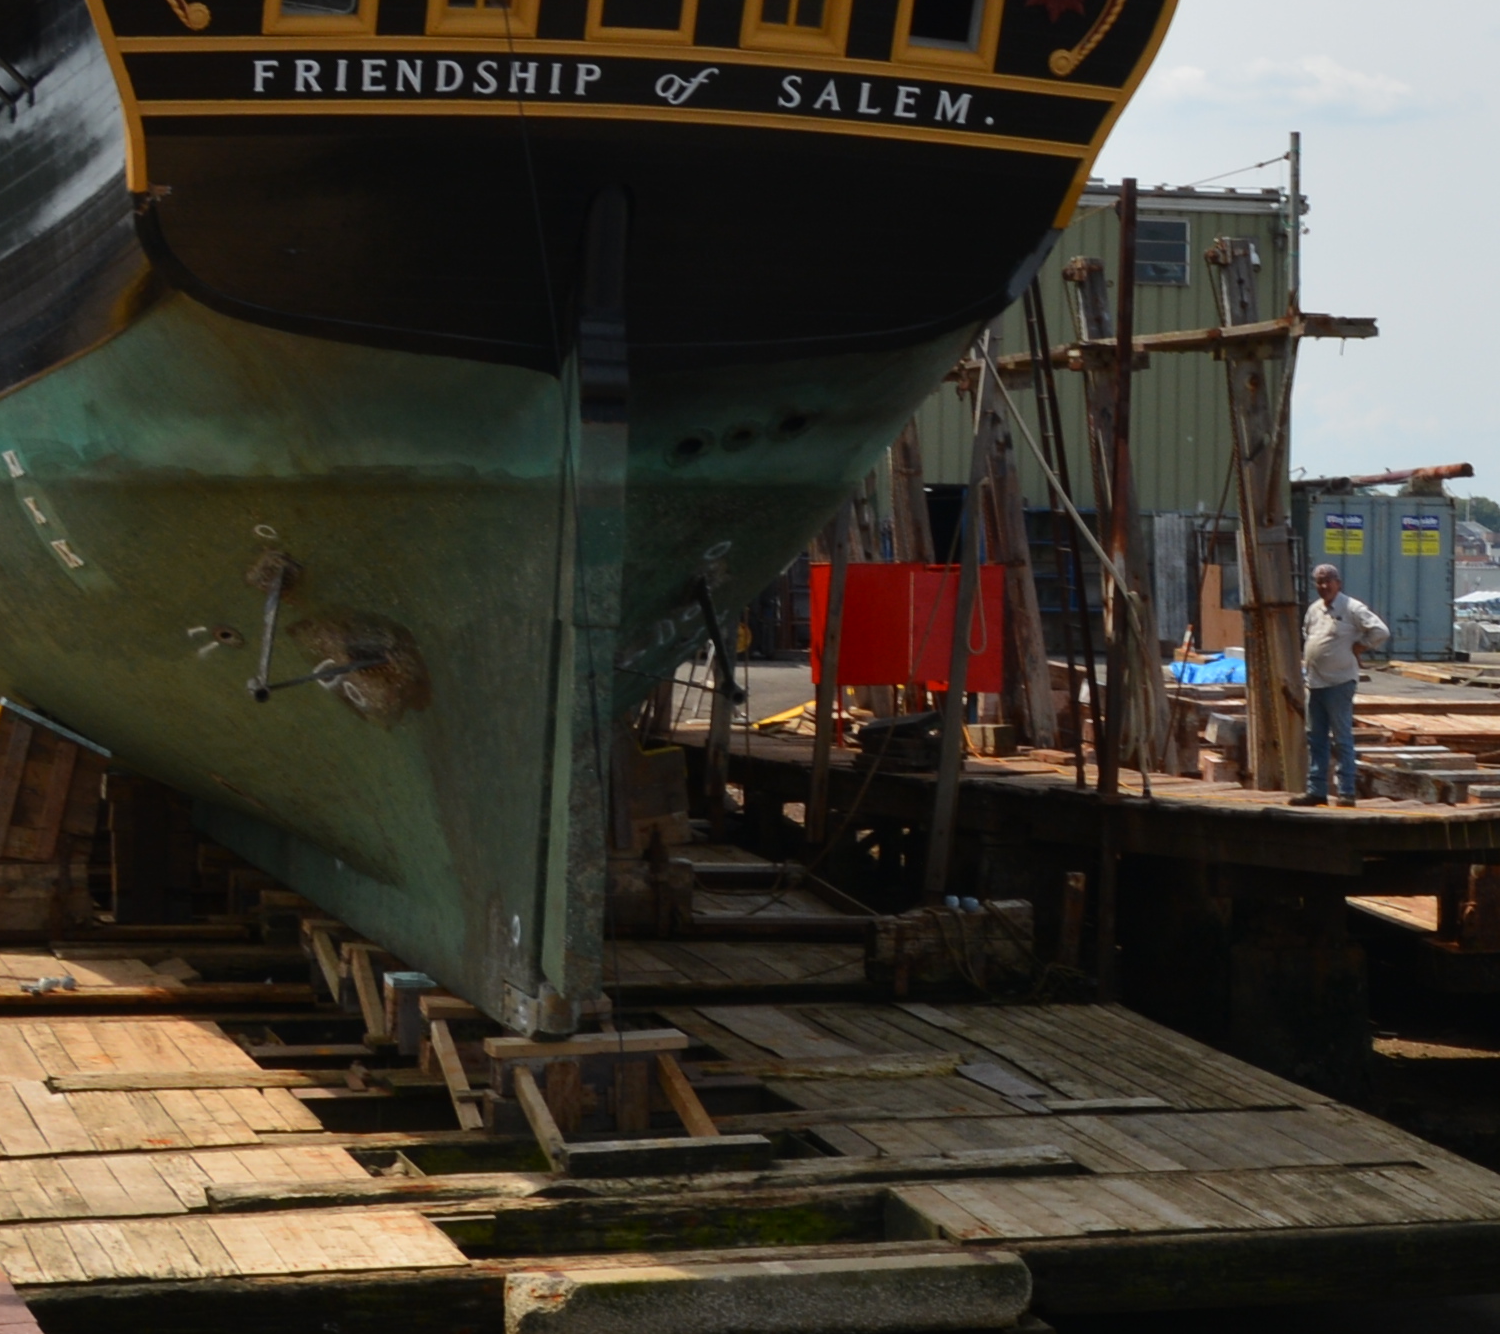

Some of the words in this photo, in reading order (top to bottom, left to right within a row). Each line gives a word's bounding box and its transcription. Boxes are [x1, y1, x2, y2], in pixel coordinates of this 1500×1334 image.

[253, 59, 602, 95] FRIENDSHIP
[655, 67, 719, 105] of
[778, 75, 995, 125] SALEM.
